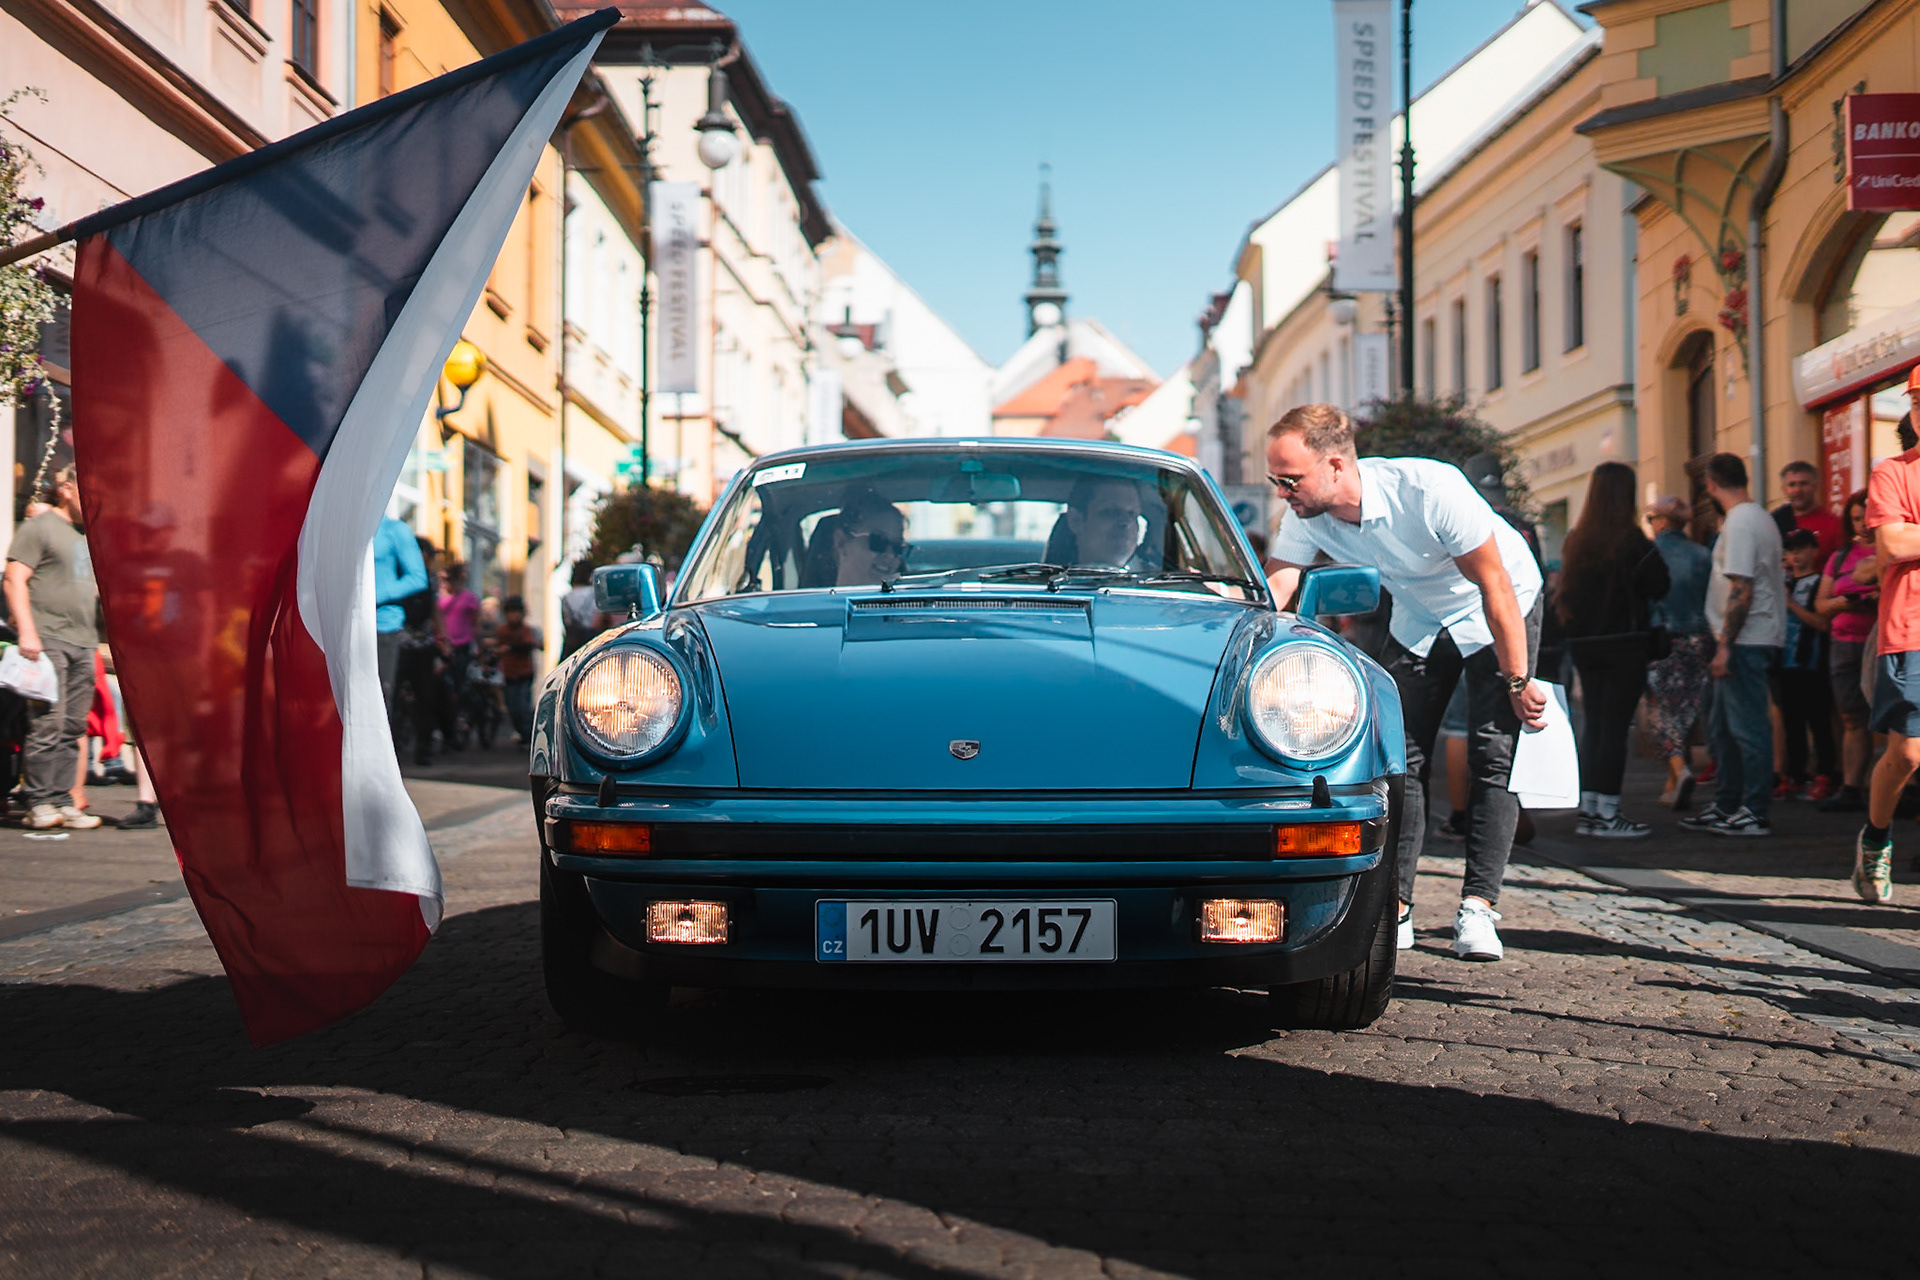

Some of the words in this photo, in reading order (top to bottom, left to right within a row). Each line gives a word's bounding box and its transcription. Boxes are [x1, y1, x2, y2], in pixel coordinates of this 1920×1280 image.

[1353, 21, 1376, 110] SPEED
[1353, 116, 1376, 244] FESTIVAL
[669, 269, 686, 361] FESTIVAL
[822, 940, 843, 954] CZ
[861, 908, 940, 954] 1UV
[980, 907, 1092, 954] 2157
